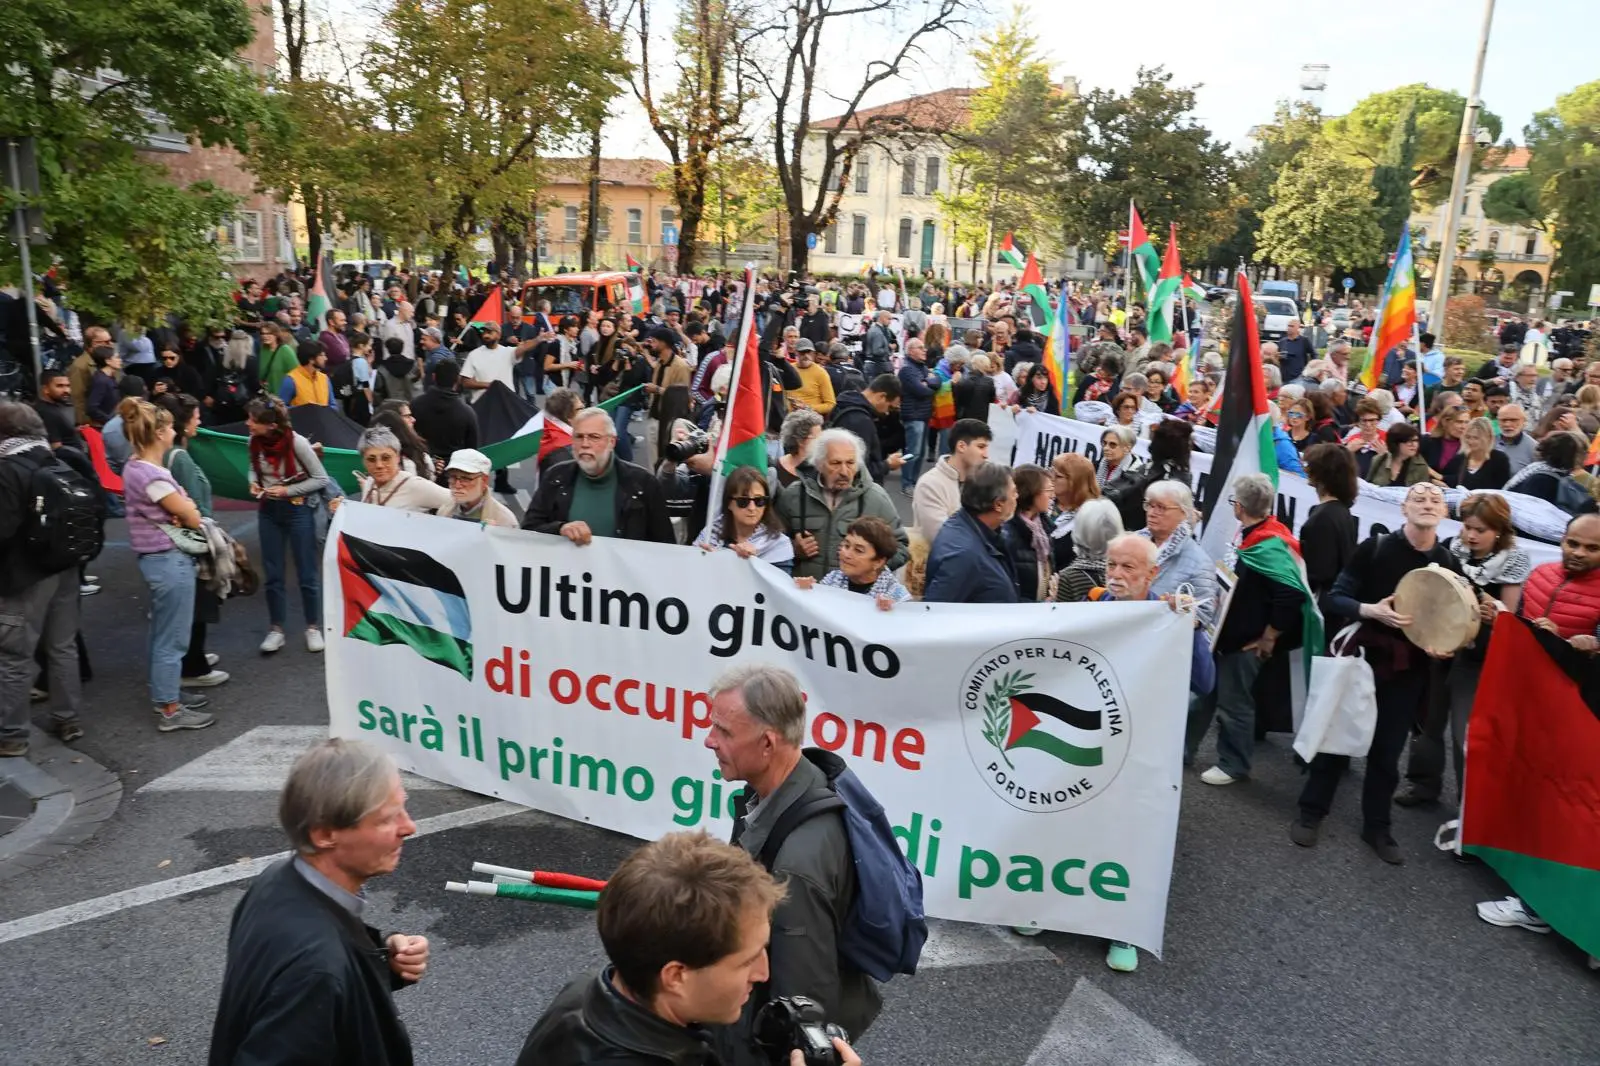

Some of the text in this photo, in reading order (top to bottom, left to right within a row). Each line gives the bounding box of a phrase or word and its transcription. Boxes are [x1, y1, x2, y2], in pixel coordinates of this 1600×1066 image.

[495, 564, 901, 679] Ultimo giorno
[485, 646, 926, 772] di occupone
[965, 647, 1124, 737] COMITATO PER LA PALESTINA
[357, 699, 444, 752] sarà
[459, 713, 485, 762] il
[498, 736, 655, 802] primo
[891, 812, 943, 877] di
[958, 845, 1130, 903] pace
[986, 762, 1093, 805] PORDENONE
